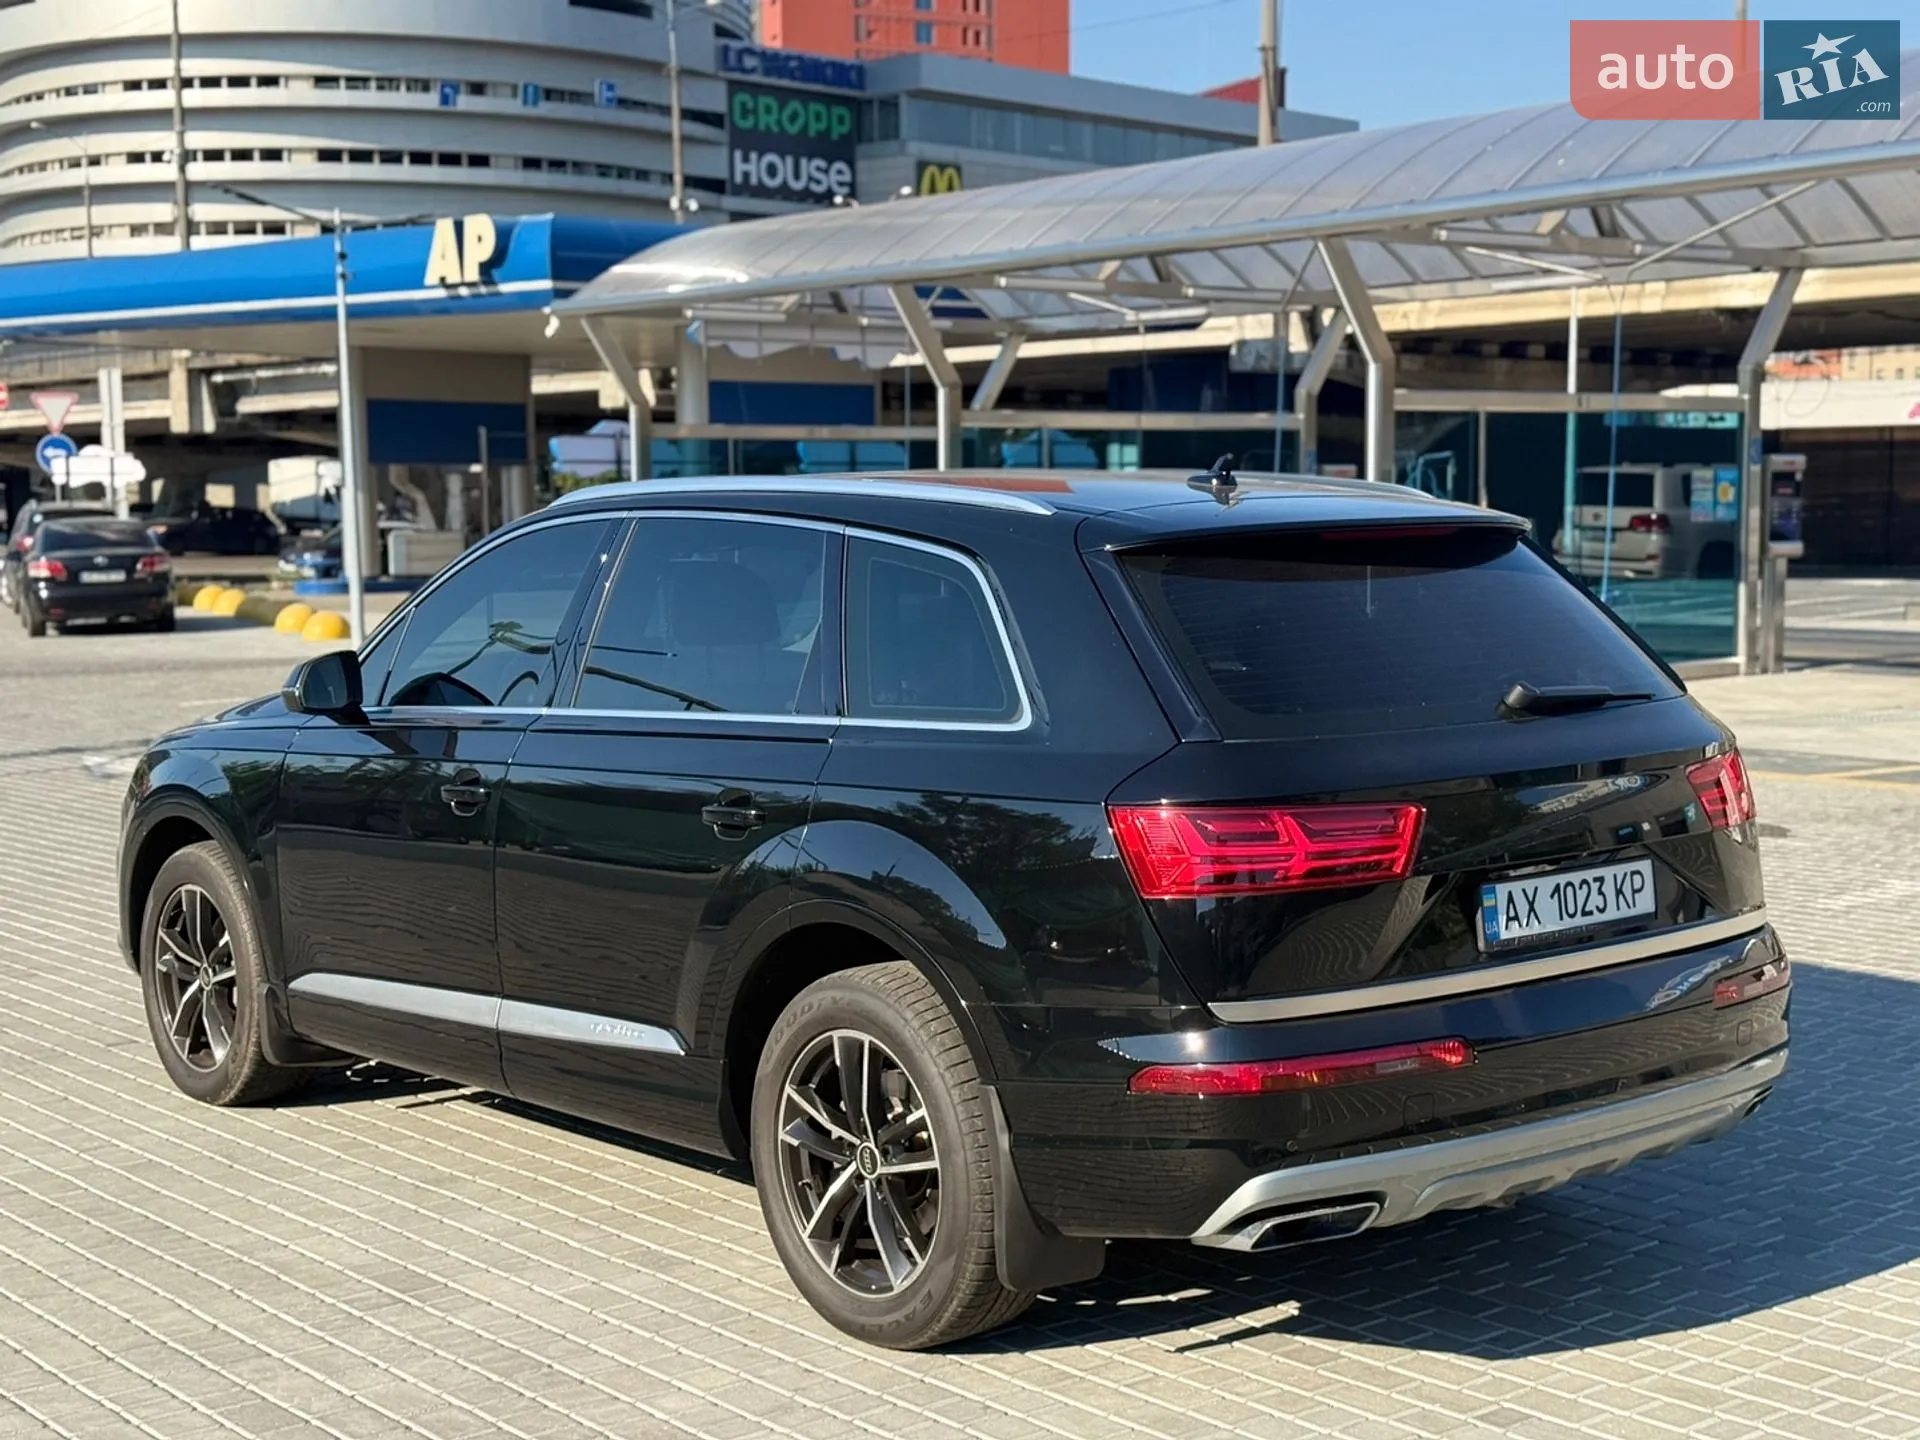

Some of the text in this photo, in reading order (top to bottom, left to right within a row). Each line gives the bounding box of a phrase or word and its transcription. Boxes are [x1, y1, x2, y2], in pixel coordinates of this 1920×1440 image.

[732, 91, 852, 141] CROPP
[1504, 869, 1646, 930] AX 1023 KP
[1485, 921, 1498, 935] UA
